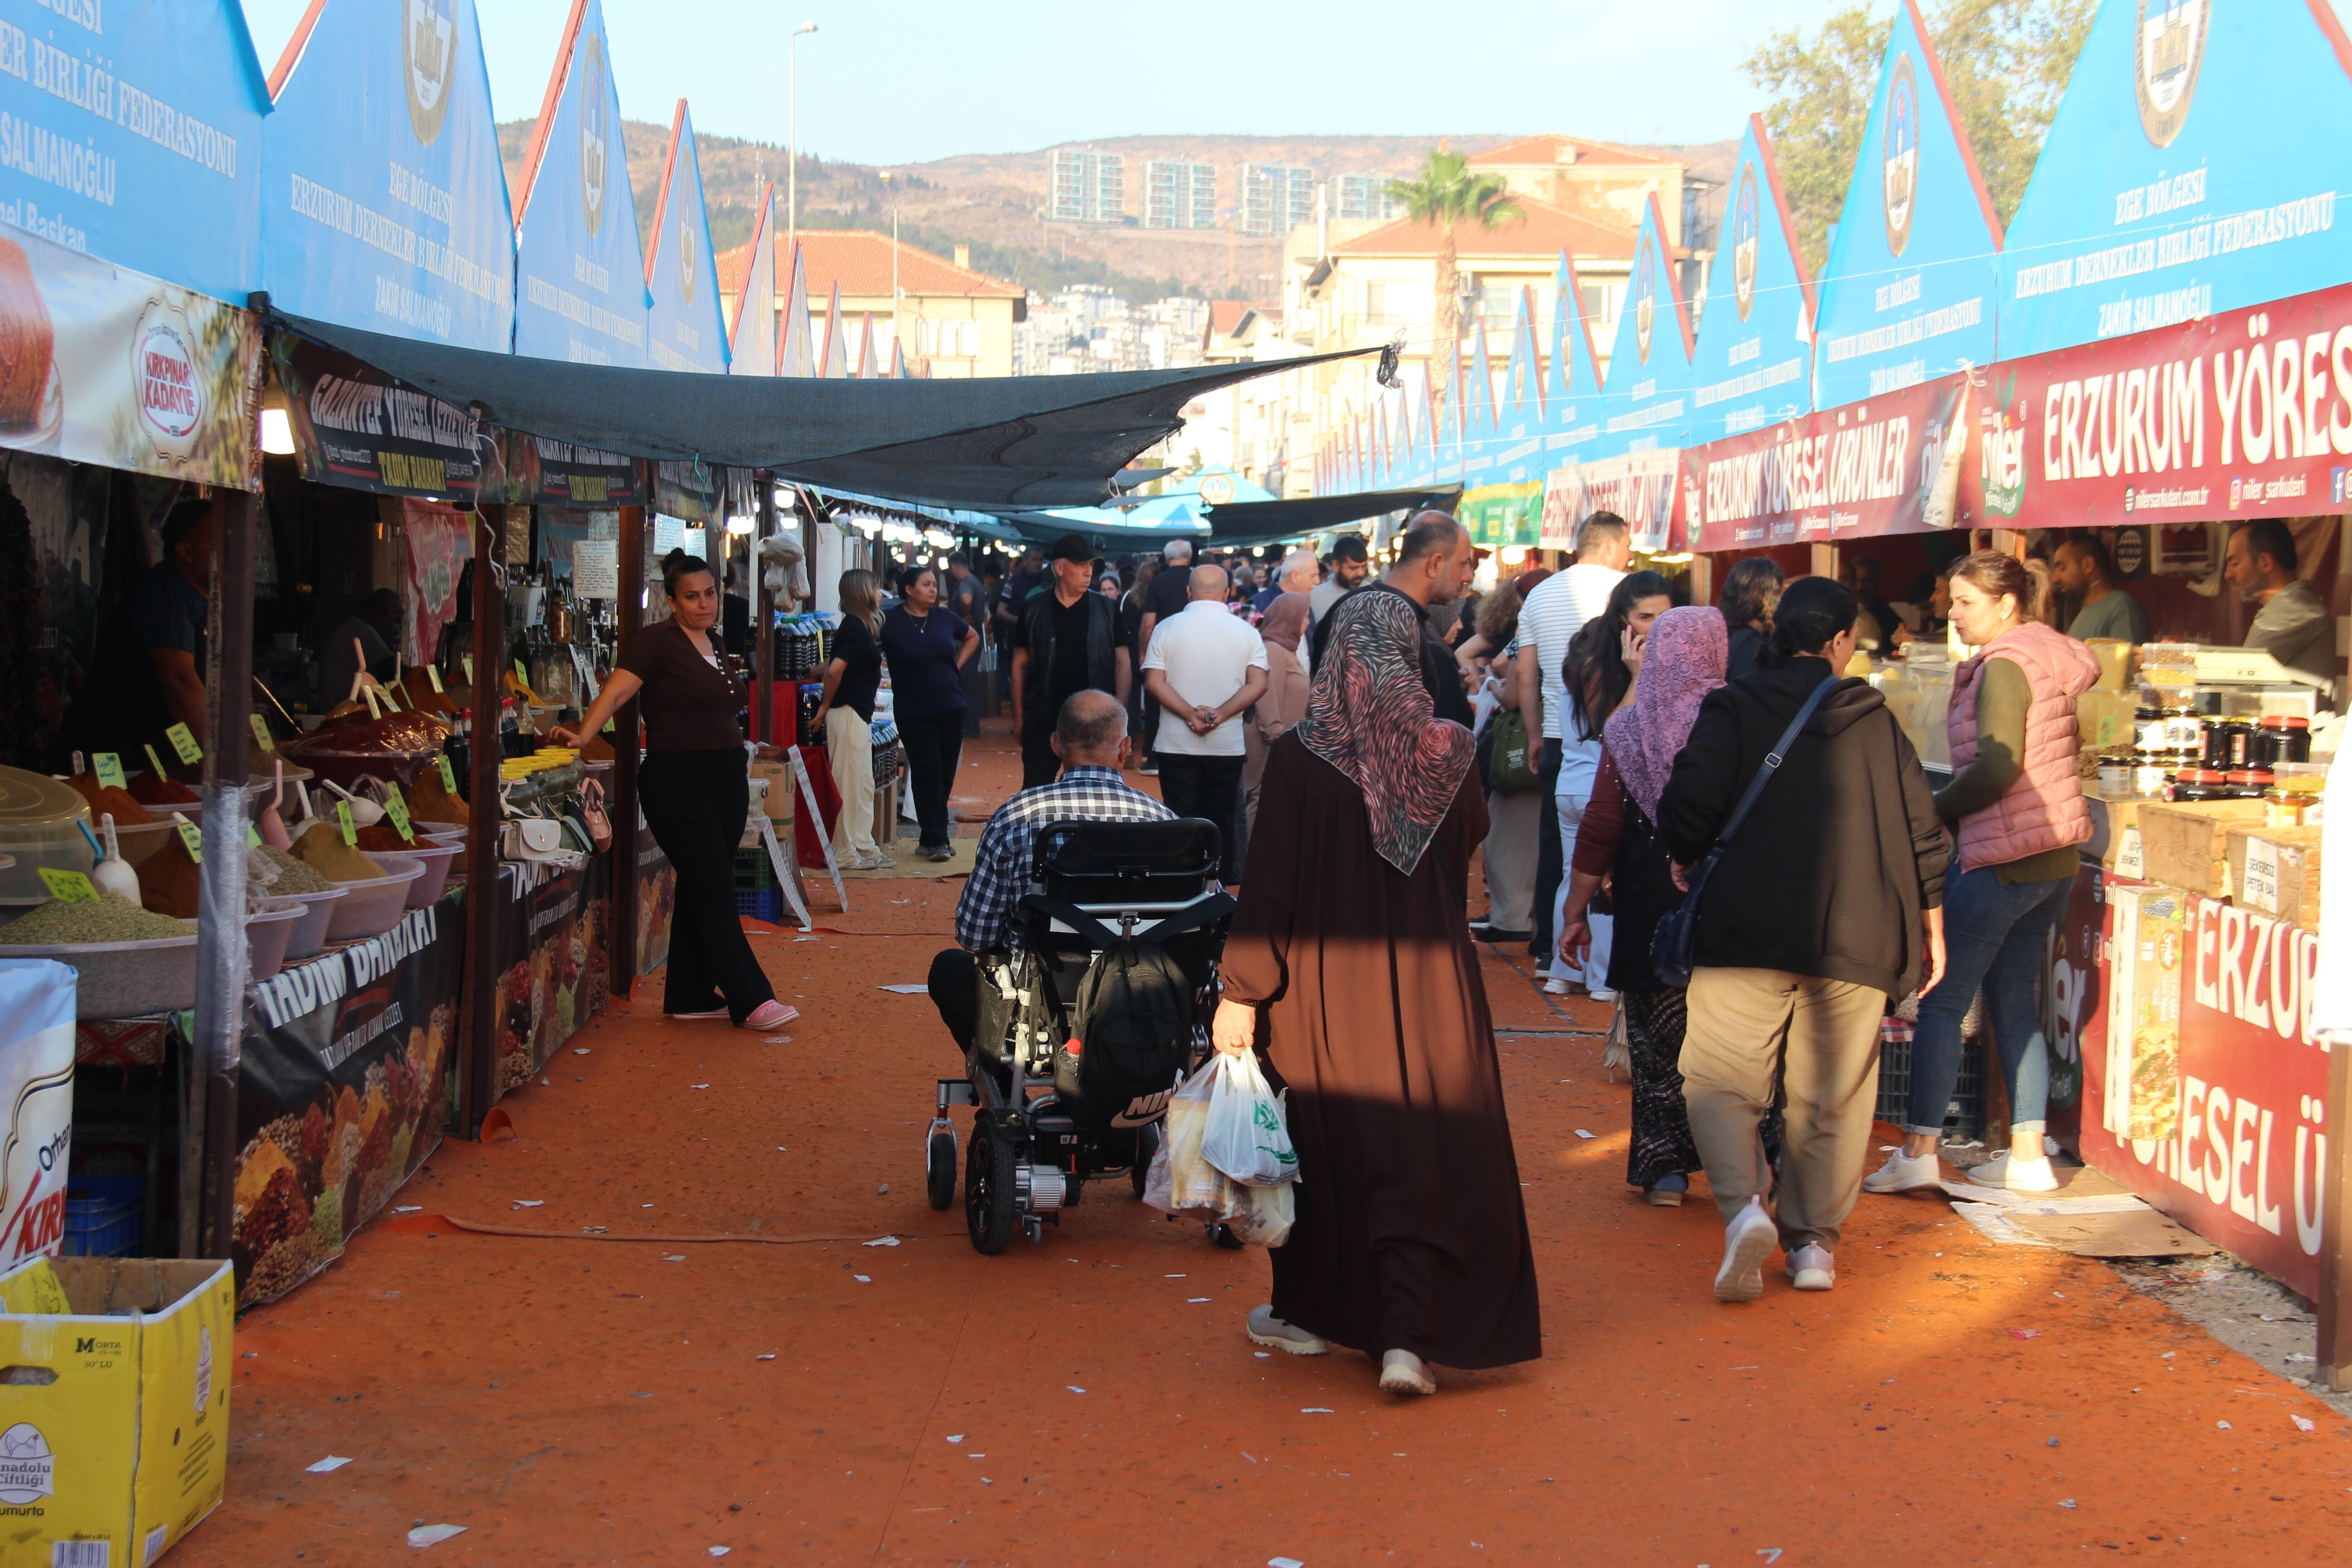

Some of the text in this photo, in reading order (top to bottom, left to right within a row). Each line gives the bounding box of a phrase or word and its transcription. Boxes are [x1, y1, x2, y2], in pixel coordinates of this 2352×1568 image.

[33, 29, 114, 122] BİRLİĞİ
[118, 79, 237, 179] FEDERASYONU
[2160, 87, 2173, 105] 2003
[1, 111, 115, 206] SALMANOĞLU
[389, 161, 453, 227] EGE BÖLGESİ
[2114, 157, 2208, 226] EGE BÖLGESİ
[291, 172, 353, 236] ERZURUM
[354, 203, 416, 266] DERNEKLER
[454, 250, 506, 308] FEDERASYONU
[2014, 190, 2336, 299] ERZURUM DERNEKLER BİRLİĞİ FEDERASYONU
[528, 274, 557, 313] ERZURUM
[559, 288, 591, 327] DERNEKLER
[575, 254, 609, 294] EGE BÖLGESİ
[1875, 267, 1921, 313] EGE BÖLGESİ
[375, 273, 451, 339] ZAKİR SALMANOĞLU
[1924, 296, 1982, 340] FEDERASYONU
[2097, 279, 2212, 338] ZAKİR SALMANOĞLU
[145, 350, 191, 387] KIRKPINAR
[145, 377, 196, 417] KADAYIF
[311, 368, 383, 435] GAZİANTEP
[384, 378, 432, 443] YÖRESEL
[2044, 356, 2203, 481] ERZURUM
[377, 451, 412, 488] TADIM
[410, 455, 446, 491] BAHARAT
[1706, 406, 1909, 524] ERZURUM YÖRESEL ÜRÜNLER
[1981, 411, 2025, 490] niler
[2135, 485, 2210, 510] nilersarkuteri.com.tr
[2242, 472, 2307, 505] niler_sarkuteri
[1507, 748, 1524, 758] CHANGE
[2246, 876, 2275, 897] PETEK BAL
